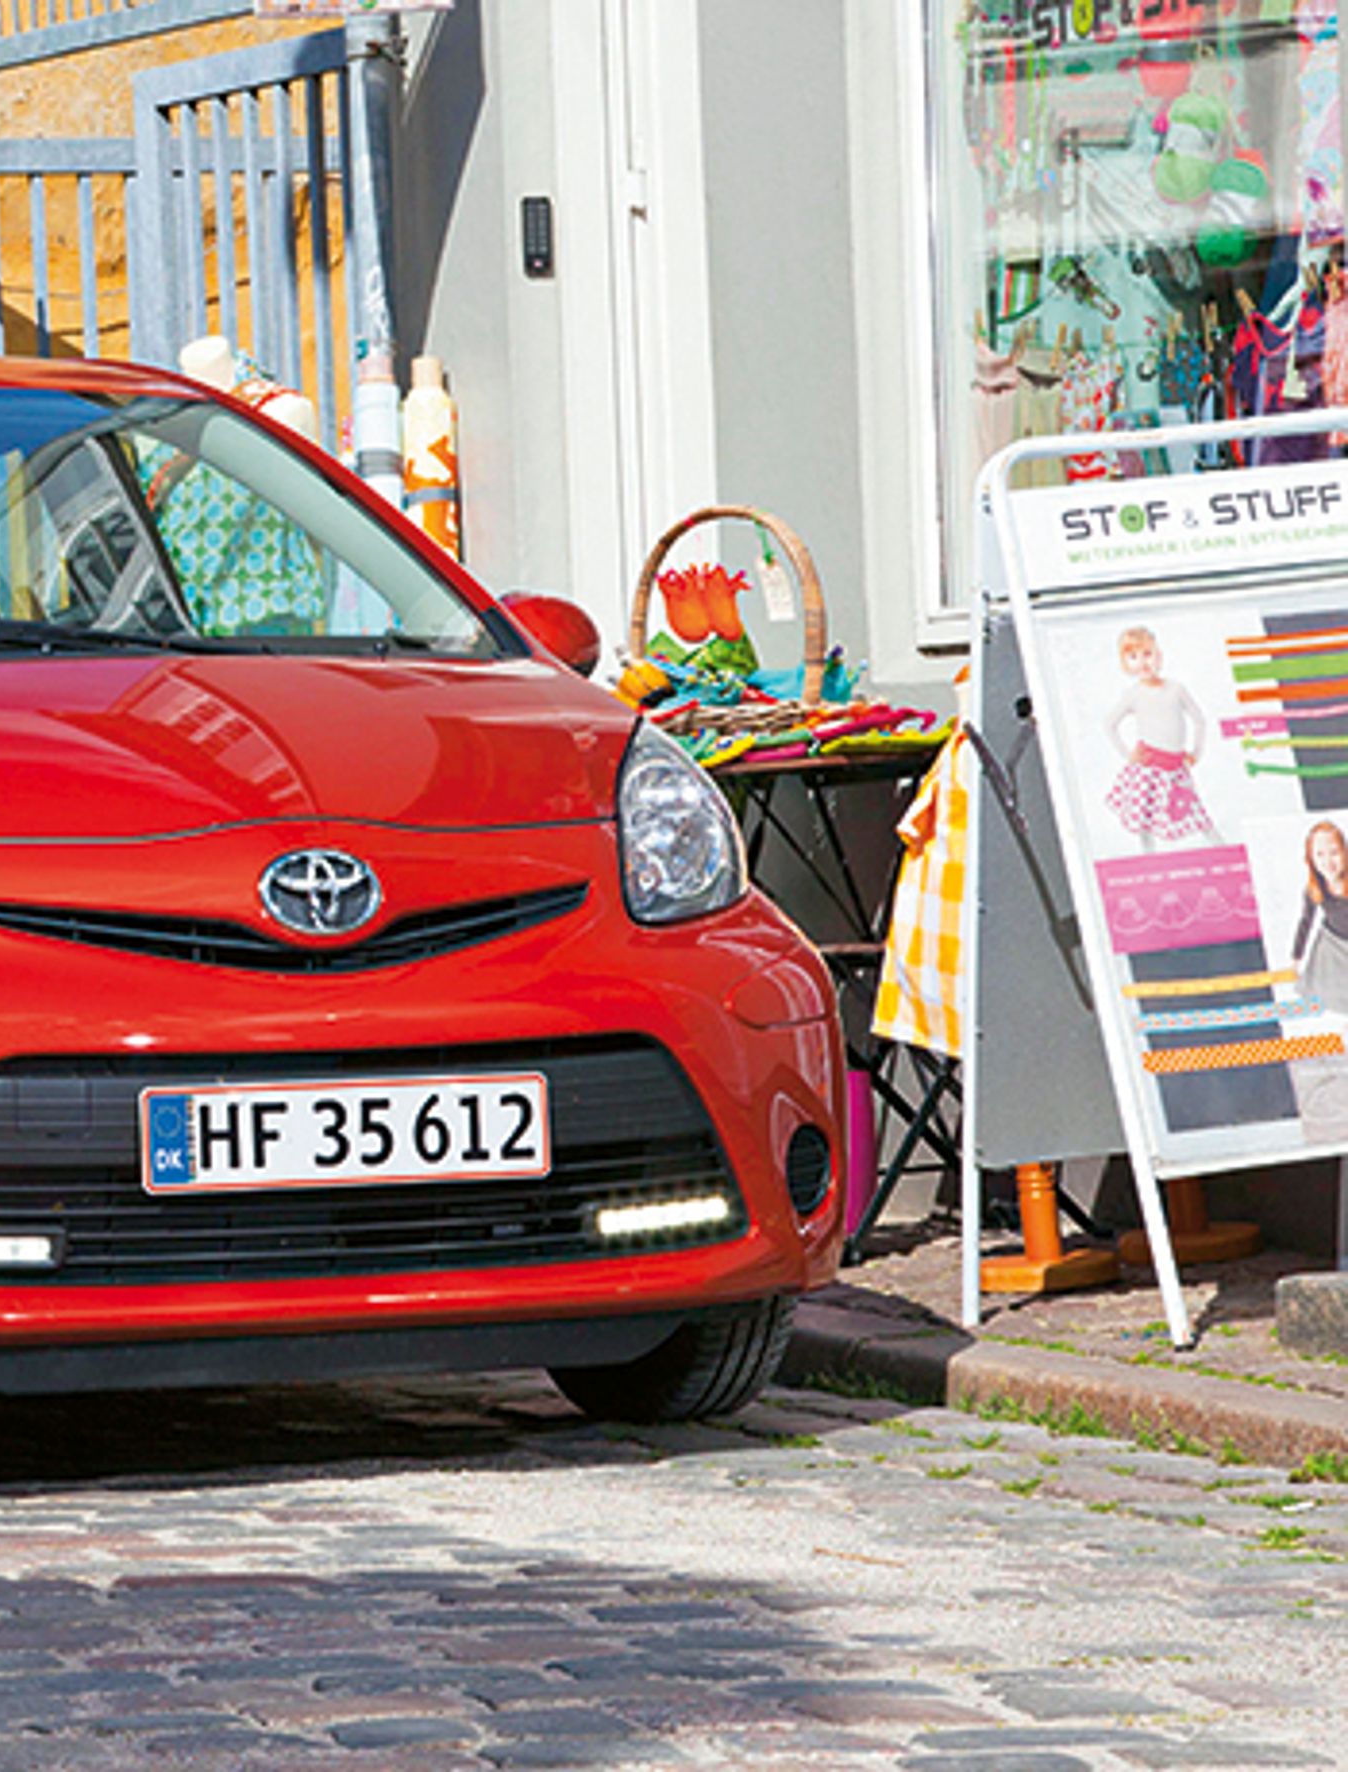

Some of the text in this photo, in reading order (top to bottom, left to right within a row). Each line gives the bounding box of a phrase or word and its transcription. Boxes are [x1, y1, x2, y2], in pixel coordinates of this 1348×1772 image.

[1061, 482, 1342, 541] STOF & STUFF
[154, 1148, 185, 1171] DK
[199, 1092, 535, 1170] HF 35 612
